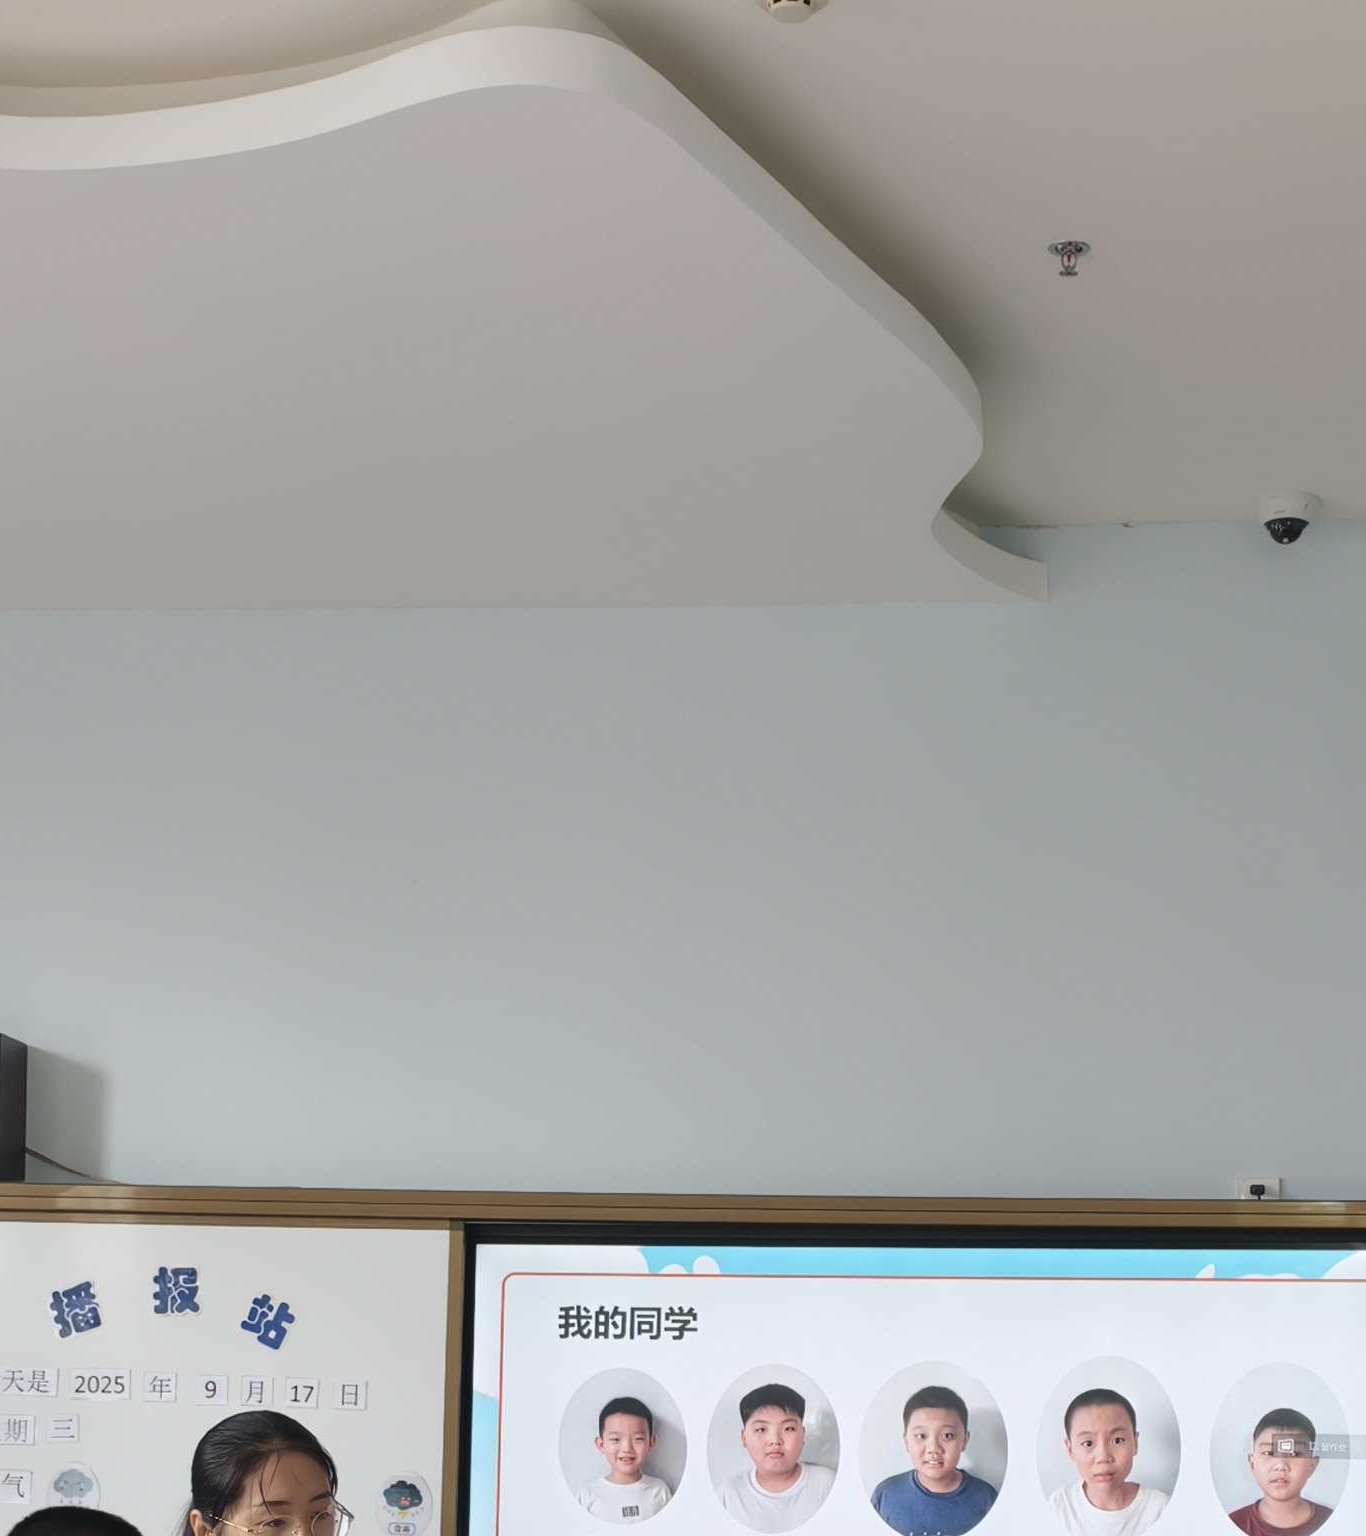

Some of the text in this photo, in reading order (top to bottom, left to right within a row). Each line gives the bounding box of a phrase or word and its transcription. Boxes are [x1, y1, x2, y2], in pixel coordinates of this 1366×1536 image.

[50, 1266, 296, 1351] 播报站
[558, 1304, 698, 1341] 我的同学
[73, 1374, 126, 1395] 2025
[148, 1376, 173, 1397] 年
[204, 1380, 218, 1399] 9
[244, 1380, 265, 1405] 月
[289, 1384, 315, 1404] 17
[341, 1384, 359, 1407] 日
[51, 1419, 76, 1440] 三
